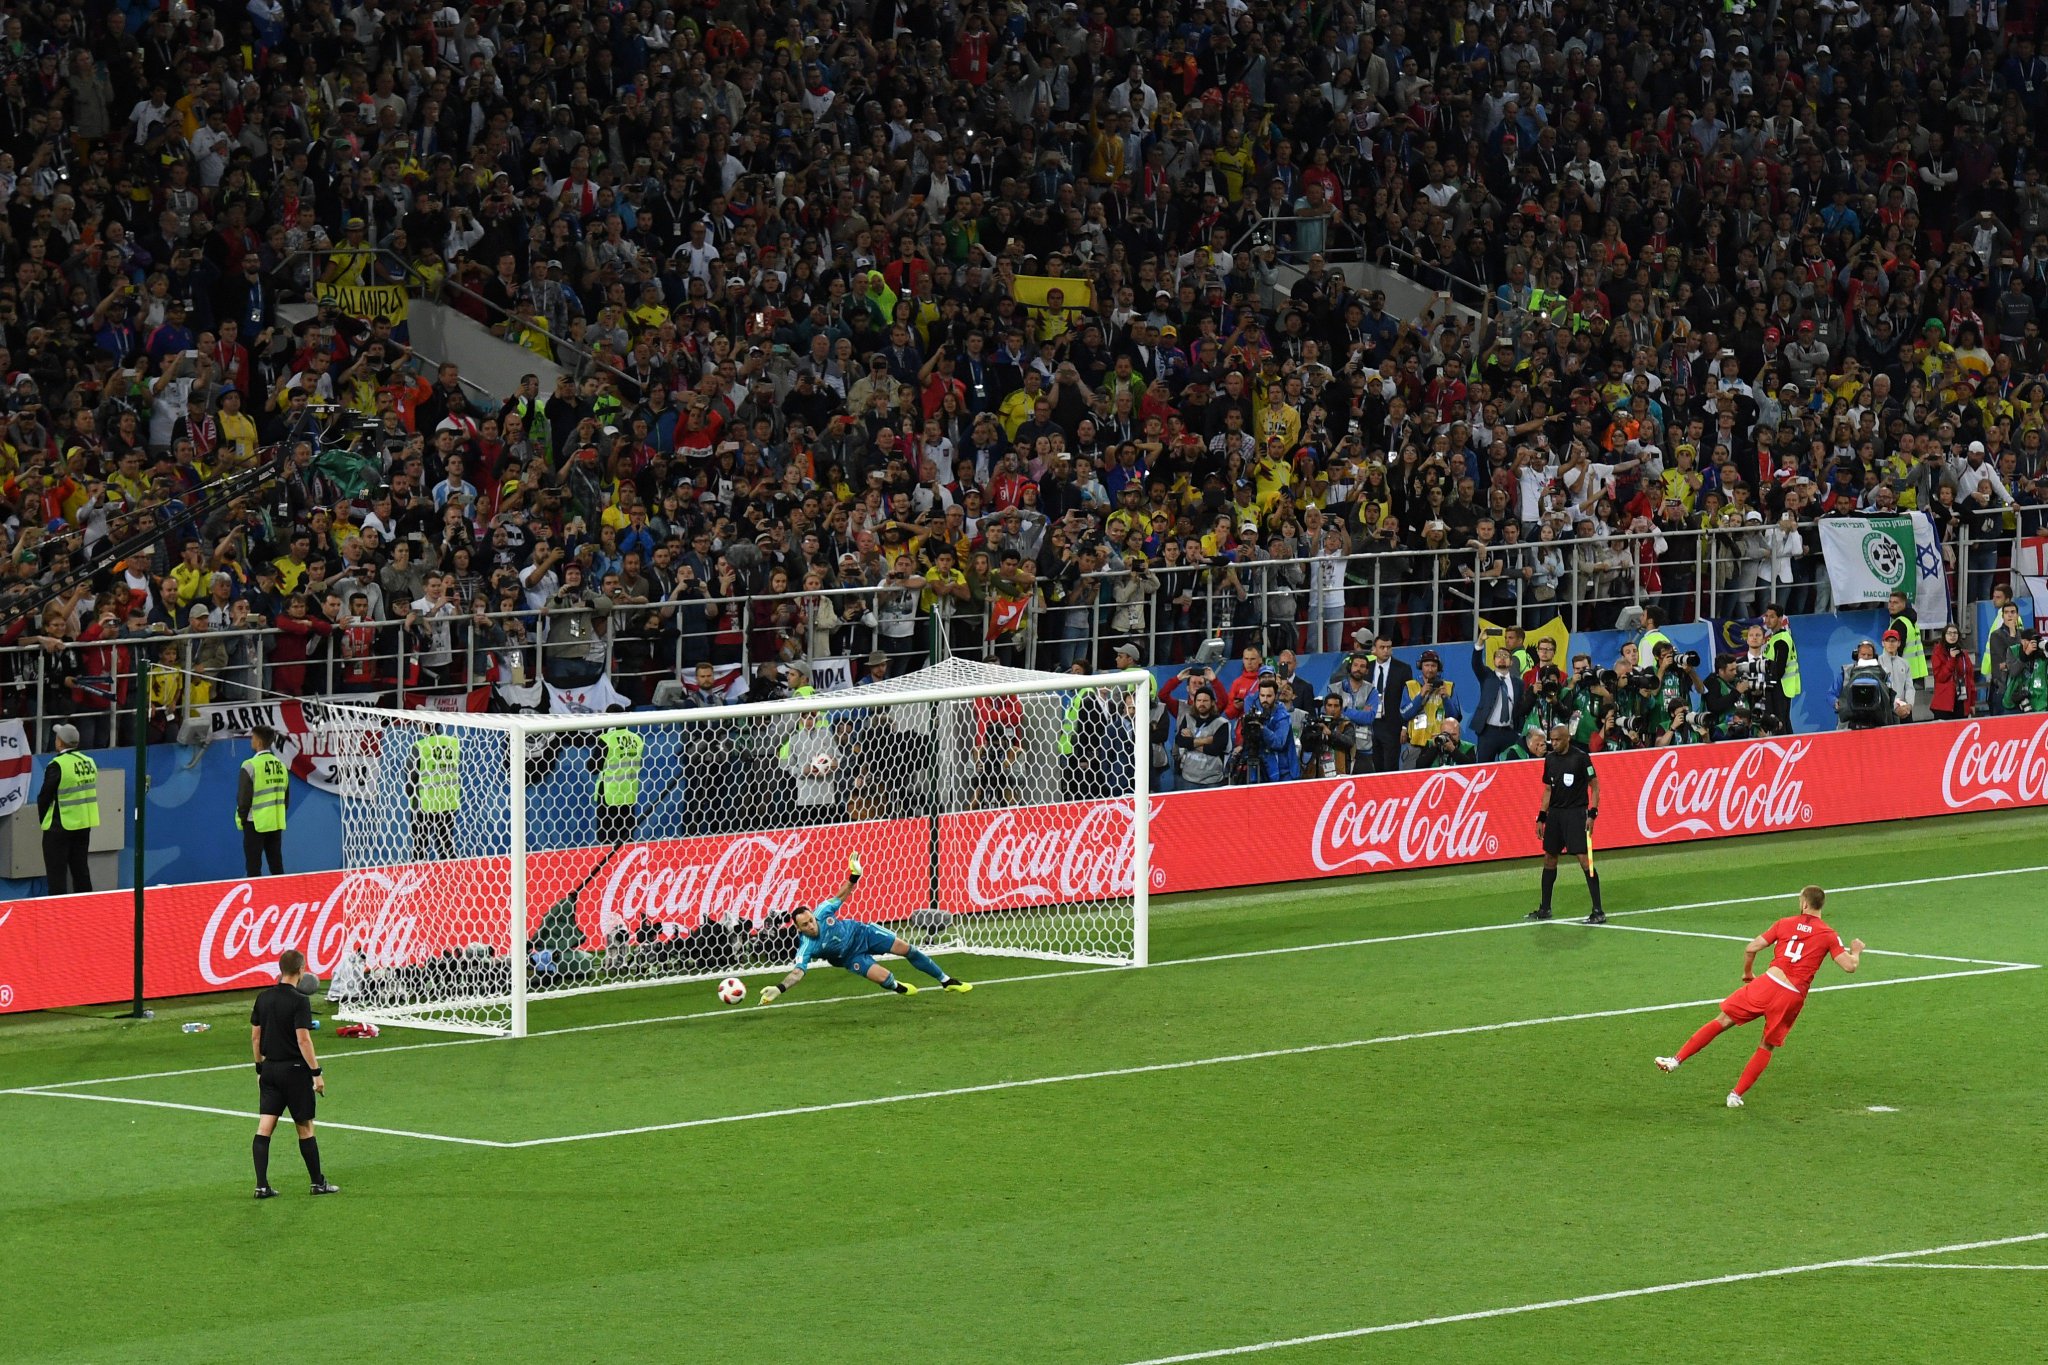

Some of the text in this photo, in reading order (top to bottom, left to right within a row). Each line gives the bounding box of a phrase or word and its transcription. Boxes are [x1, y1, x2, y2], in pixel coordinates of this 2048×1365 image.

[326, 284, 403, 316] PALMIRA
[1863, 590, 1890, 599] MACCAB
[212, 705, 275, 732] BARRY
[0, 786, 22, 809] PEY
[1638, 738, 1814, 839] Coca-Cola
[1311, 767, 1499, 872] Coca-Cola
[968, 799, 1166, 907] Coca-Cola
[599, 832, 812, 937] Coca-Cola
[198, 868, 430, 985] Coca-Cola
[1796, 923, 1813, 934] DIER
[1784, 935, 1805, 963] 4
